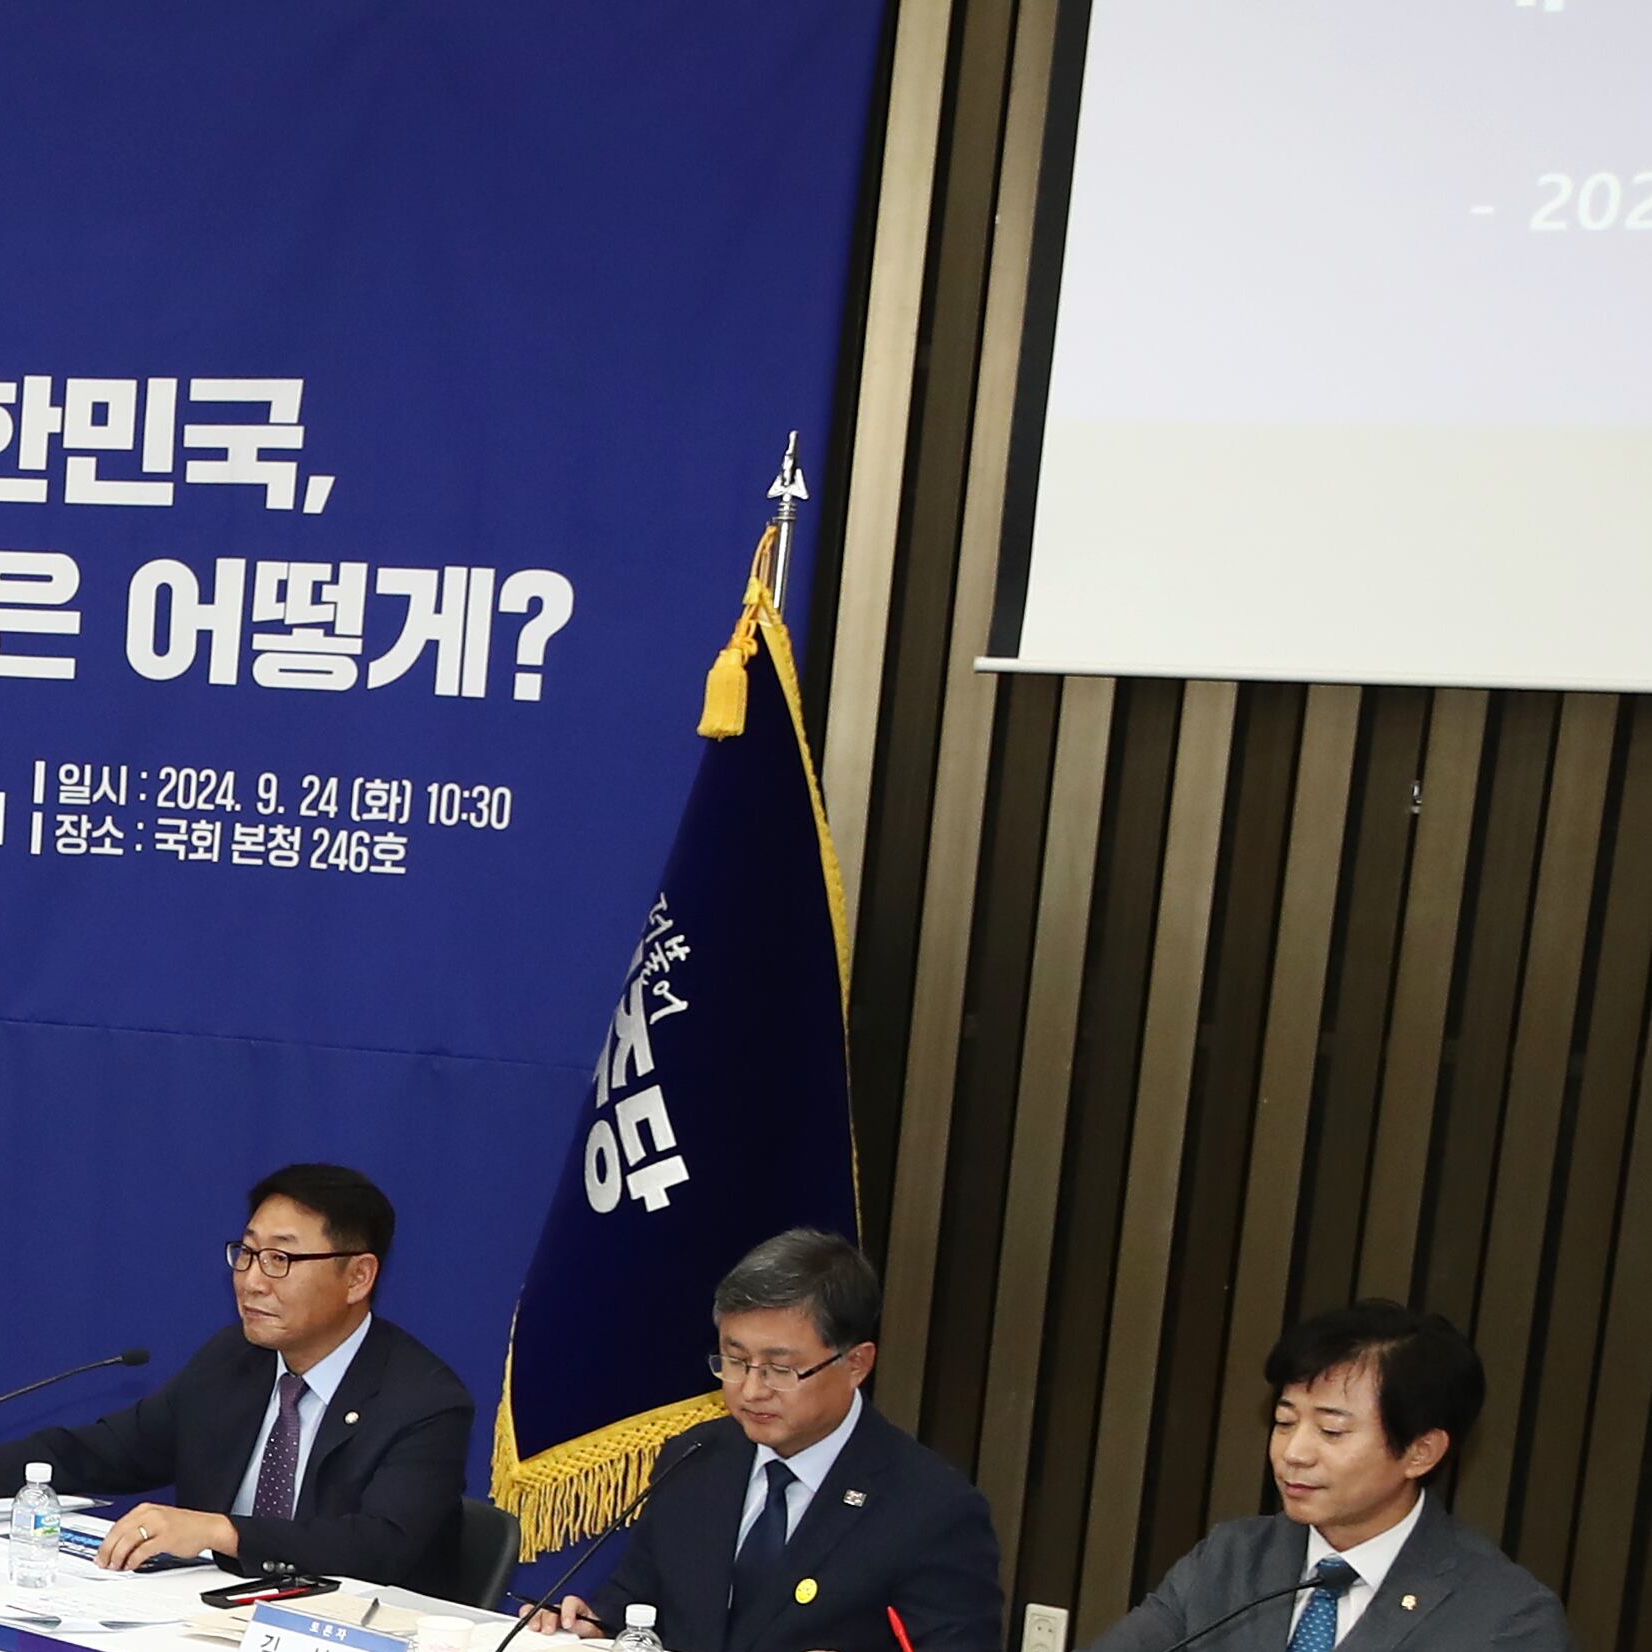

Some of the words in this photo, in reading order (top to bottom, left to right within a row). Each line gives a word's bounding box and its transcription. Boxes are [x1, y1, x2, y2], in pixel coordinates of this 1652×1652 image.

[126, 556, 575, 701] 어떻게?
[58, 763, 128, 806] 일시
[156, 766, 243, 812] 2024.
[255, 772, 286, 815] 9.
[299, 774, 339, 819] 24
[350, 777, 412, 824] (화)
[426, 782, 513, 830] 10:30
[55, 814, 125, 856] 장소
[154, 818, 222, 863] 국회
[231, 822, 302, 868] 본청
[310, 828, 408, 874] 246호
